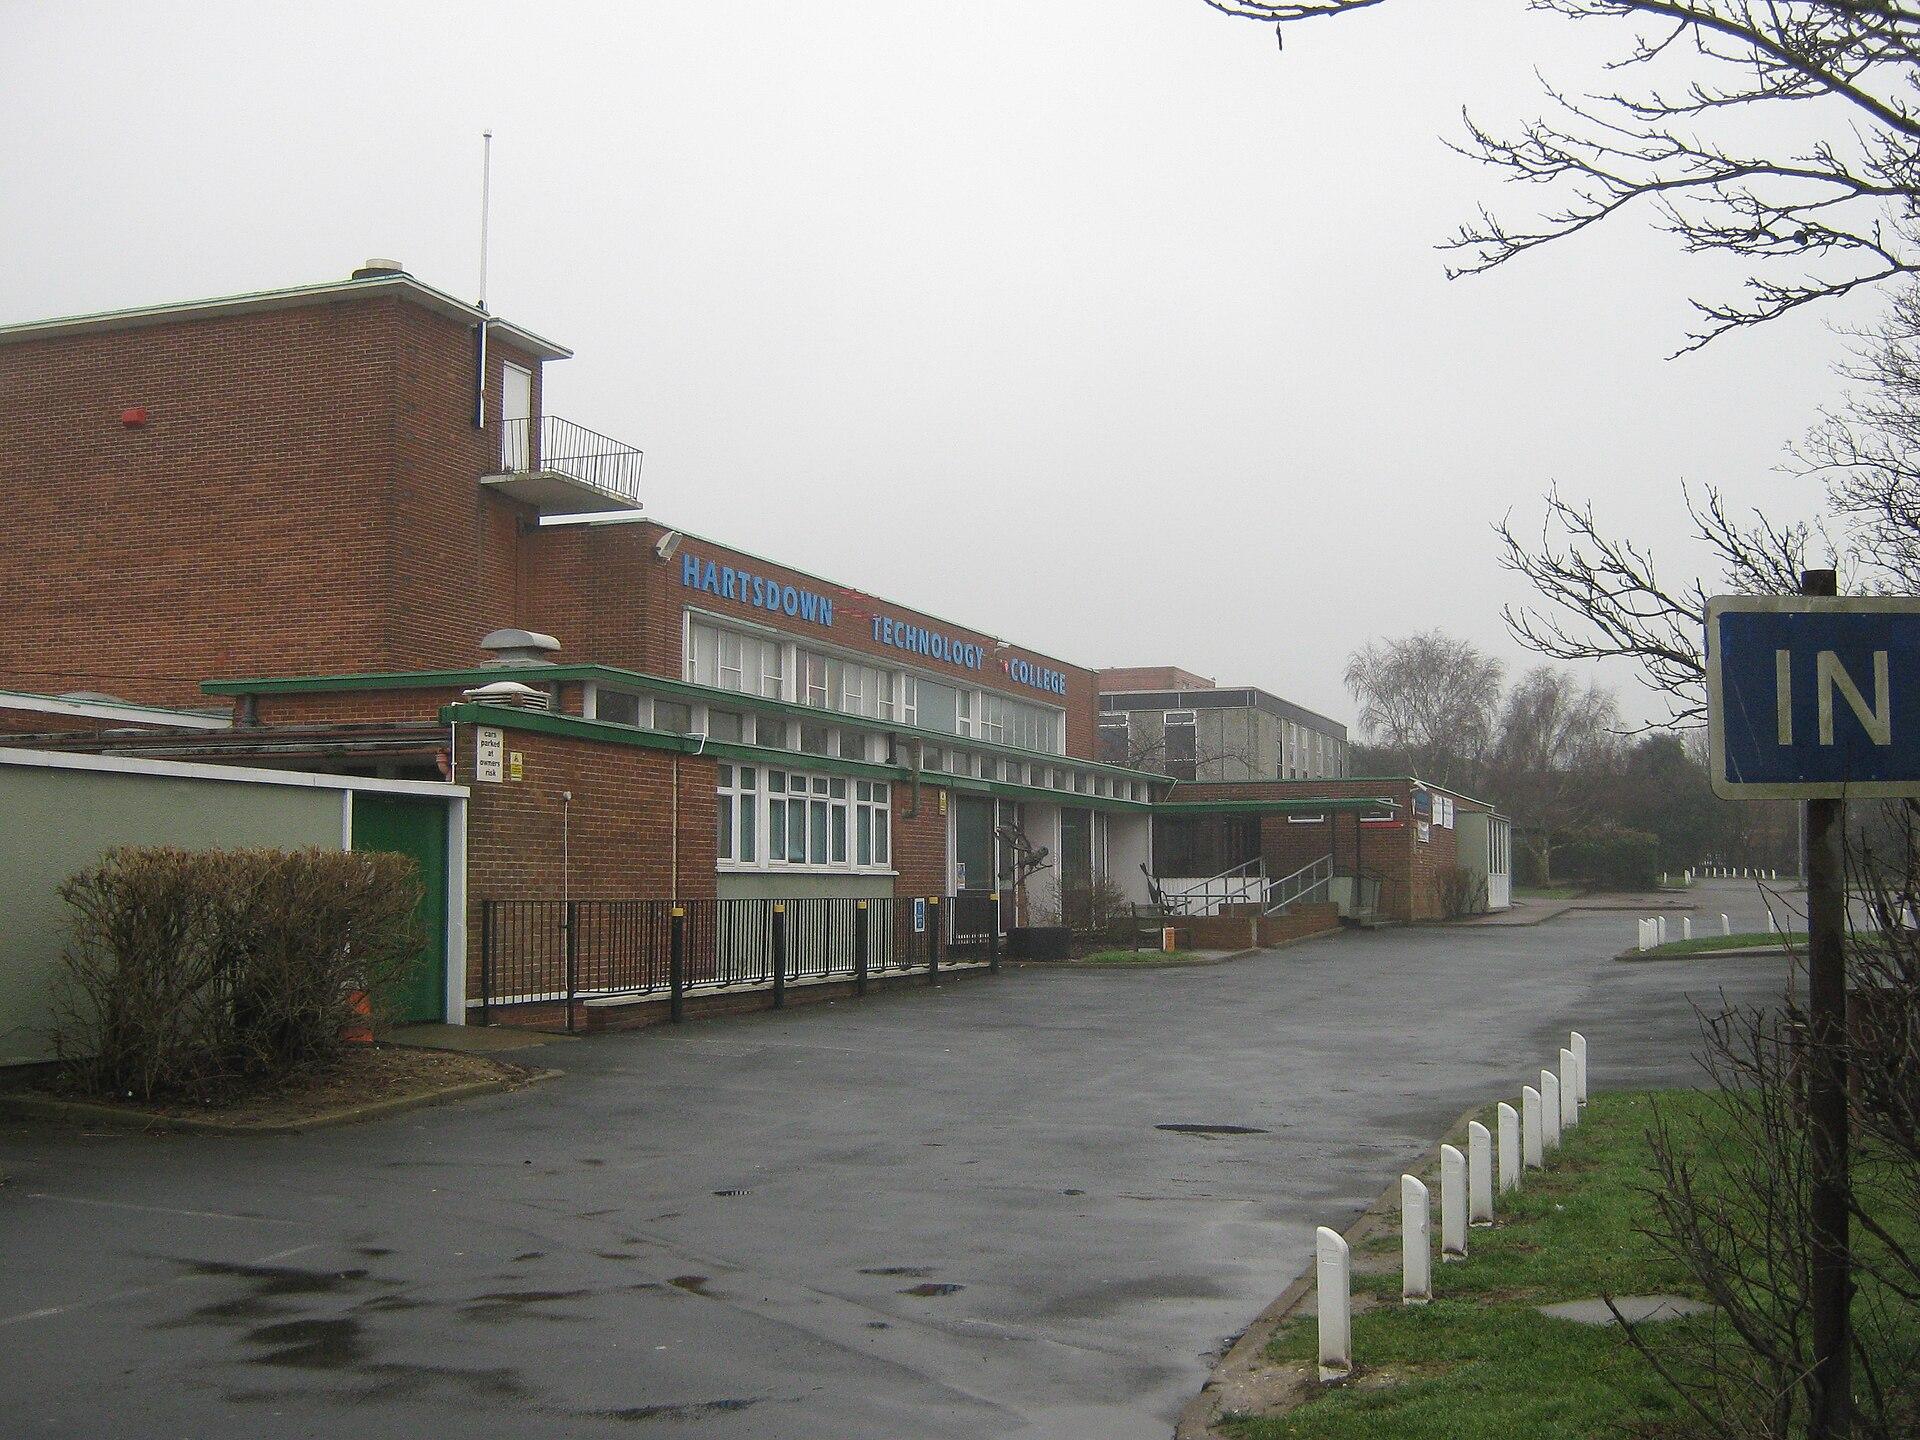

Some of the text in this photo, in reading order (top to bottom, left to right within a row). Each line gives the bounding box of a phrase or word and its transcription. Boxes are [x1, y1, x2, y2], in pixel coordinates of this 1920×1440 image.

[682, 553, 1067, 695] HARTSDOWN TECHNOLOGY COLLEGE
[1776, 649, 1891, 746] IN
[480, 740, 501, 748] parked
[485, 769, 497, 777] risk
